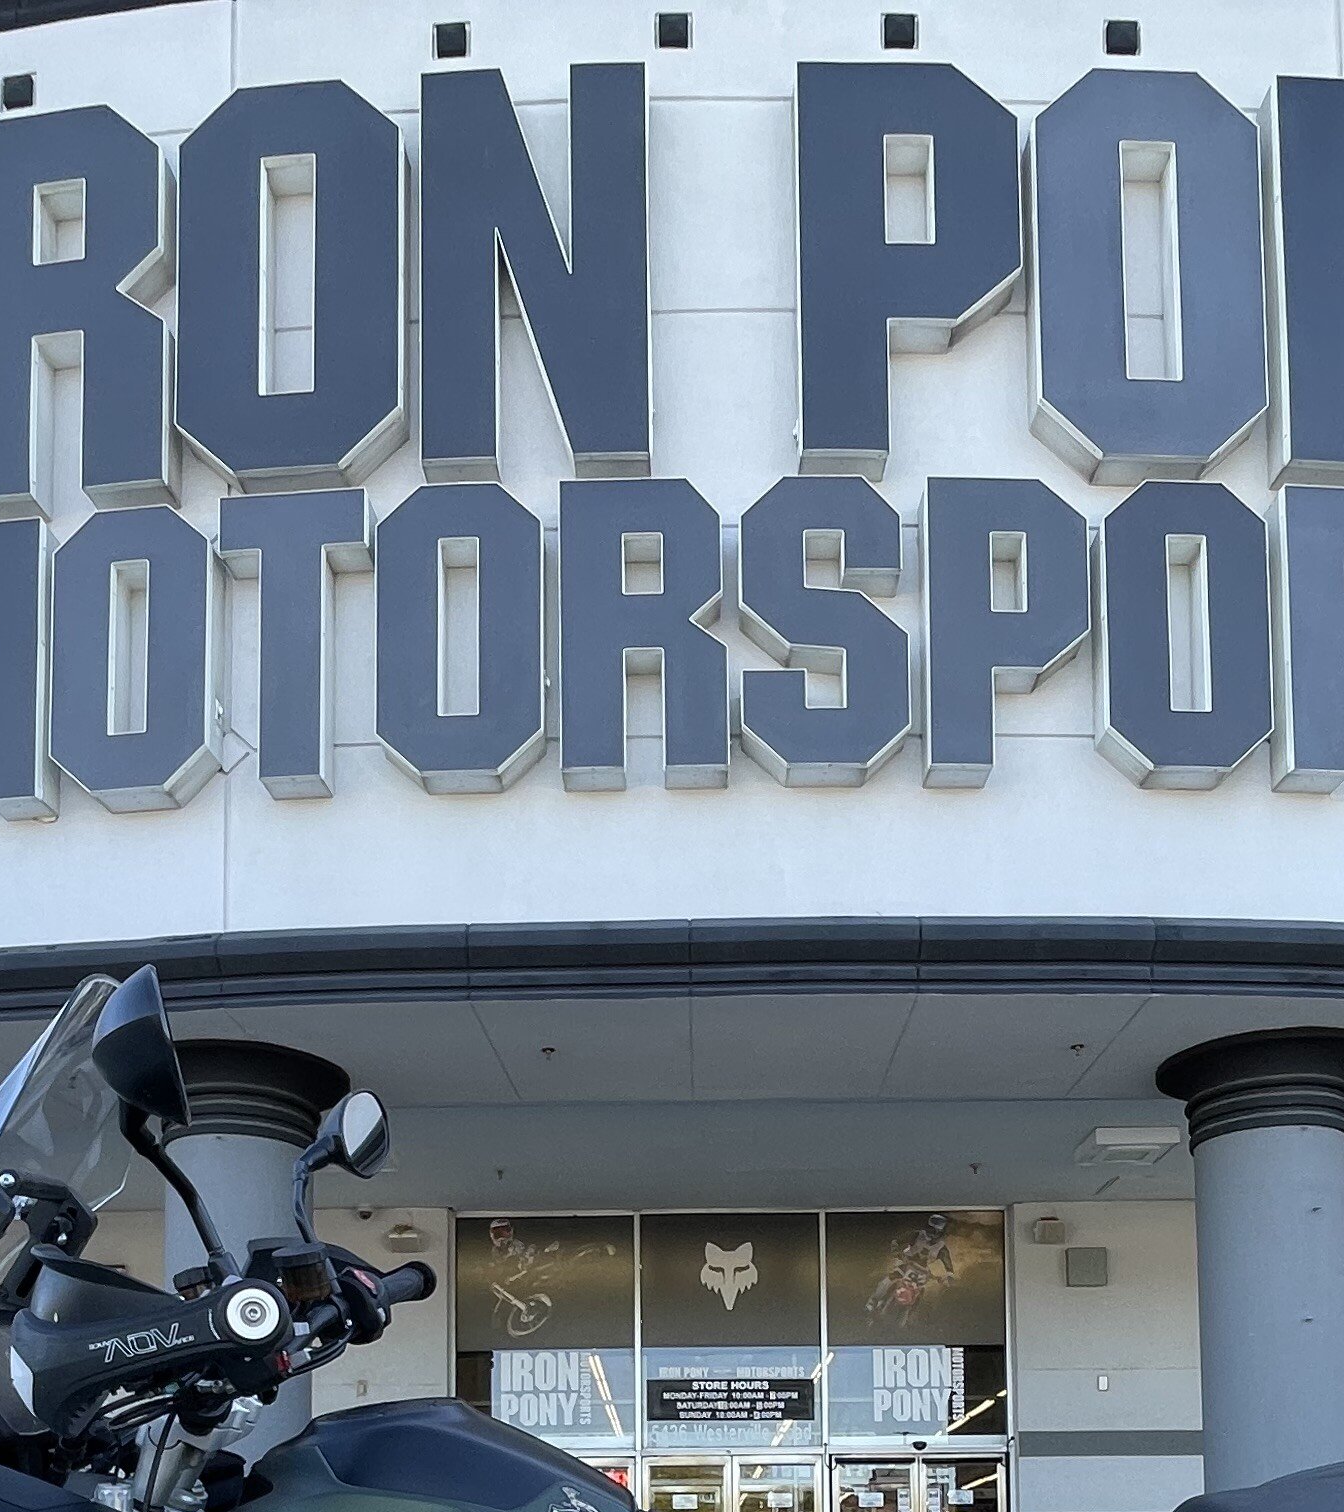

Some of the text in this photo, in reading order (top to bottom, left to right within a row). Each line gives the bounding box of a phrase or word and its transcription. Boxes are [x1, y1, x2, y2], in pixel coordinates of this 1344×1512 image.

[501, 1352, 578, 1391] IRON
[659, 1367, 805, 1378] IRON PONY MOTORSPORTS
[873, 1348, 952, 1388] IRON
[952, 1348, 964, 1420] MOTORSPORTS
[692, 1381, 769, 1390] STORE HOURS
[501, 1393, 578, 1426] PONY
[874, 1388, 952, 1421] PONY
[693, 1423, 769, 1442] Westerville
